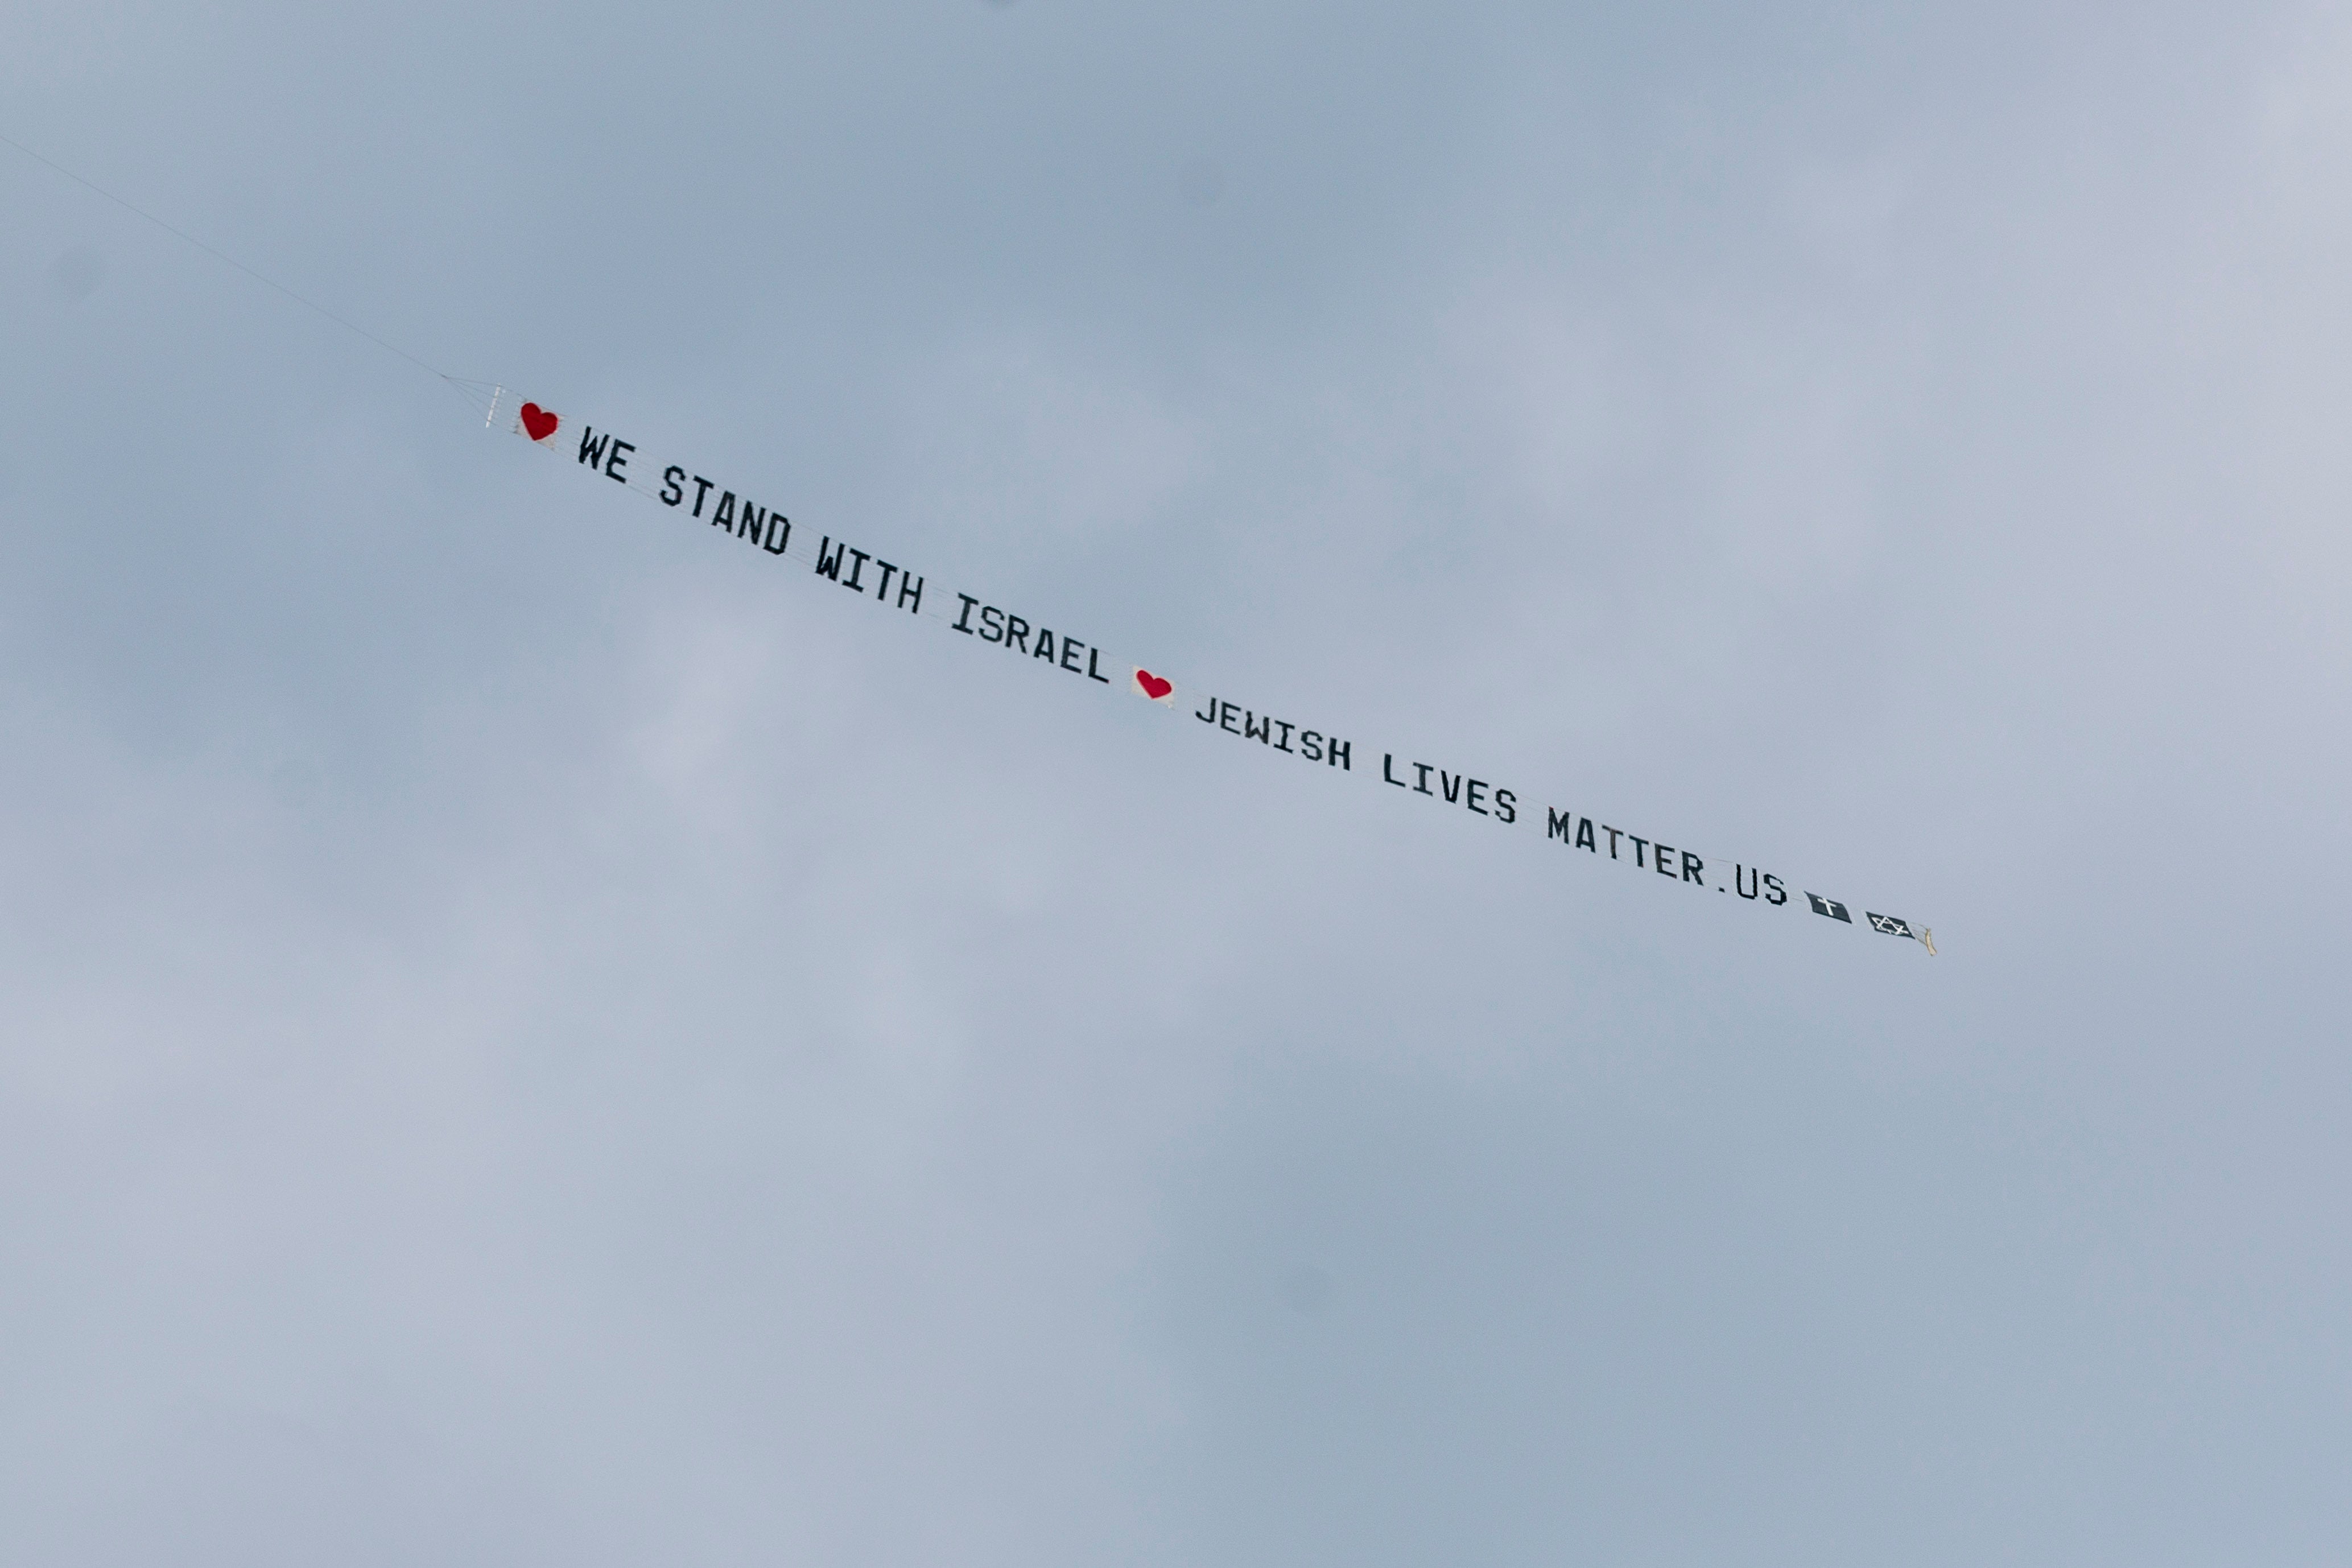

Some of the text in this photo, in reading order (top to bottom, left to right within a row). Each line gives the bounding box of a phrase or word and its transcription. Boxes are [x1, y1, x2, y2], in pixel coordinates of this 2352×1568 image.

[578, 426, 636, 484] WE
[659, 465, 792, 556] STAND
[815, 535, 924, 614] WITH
[951, 592, 1110, 684] ISRAEL
[1195, 696, 1351, 771] JEWISH
[1383, 753, 1517, 824] LIVES
